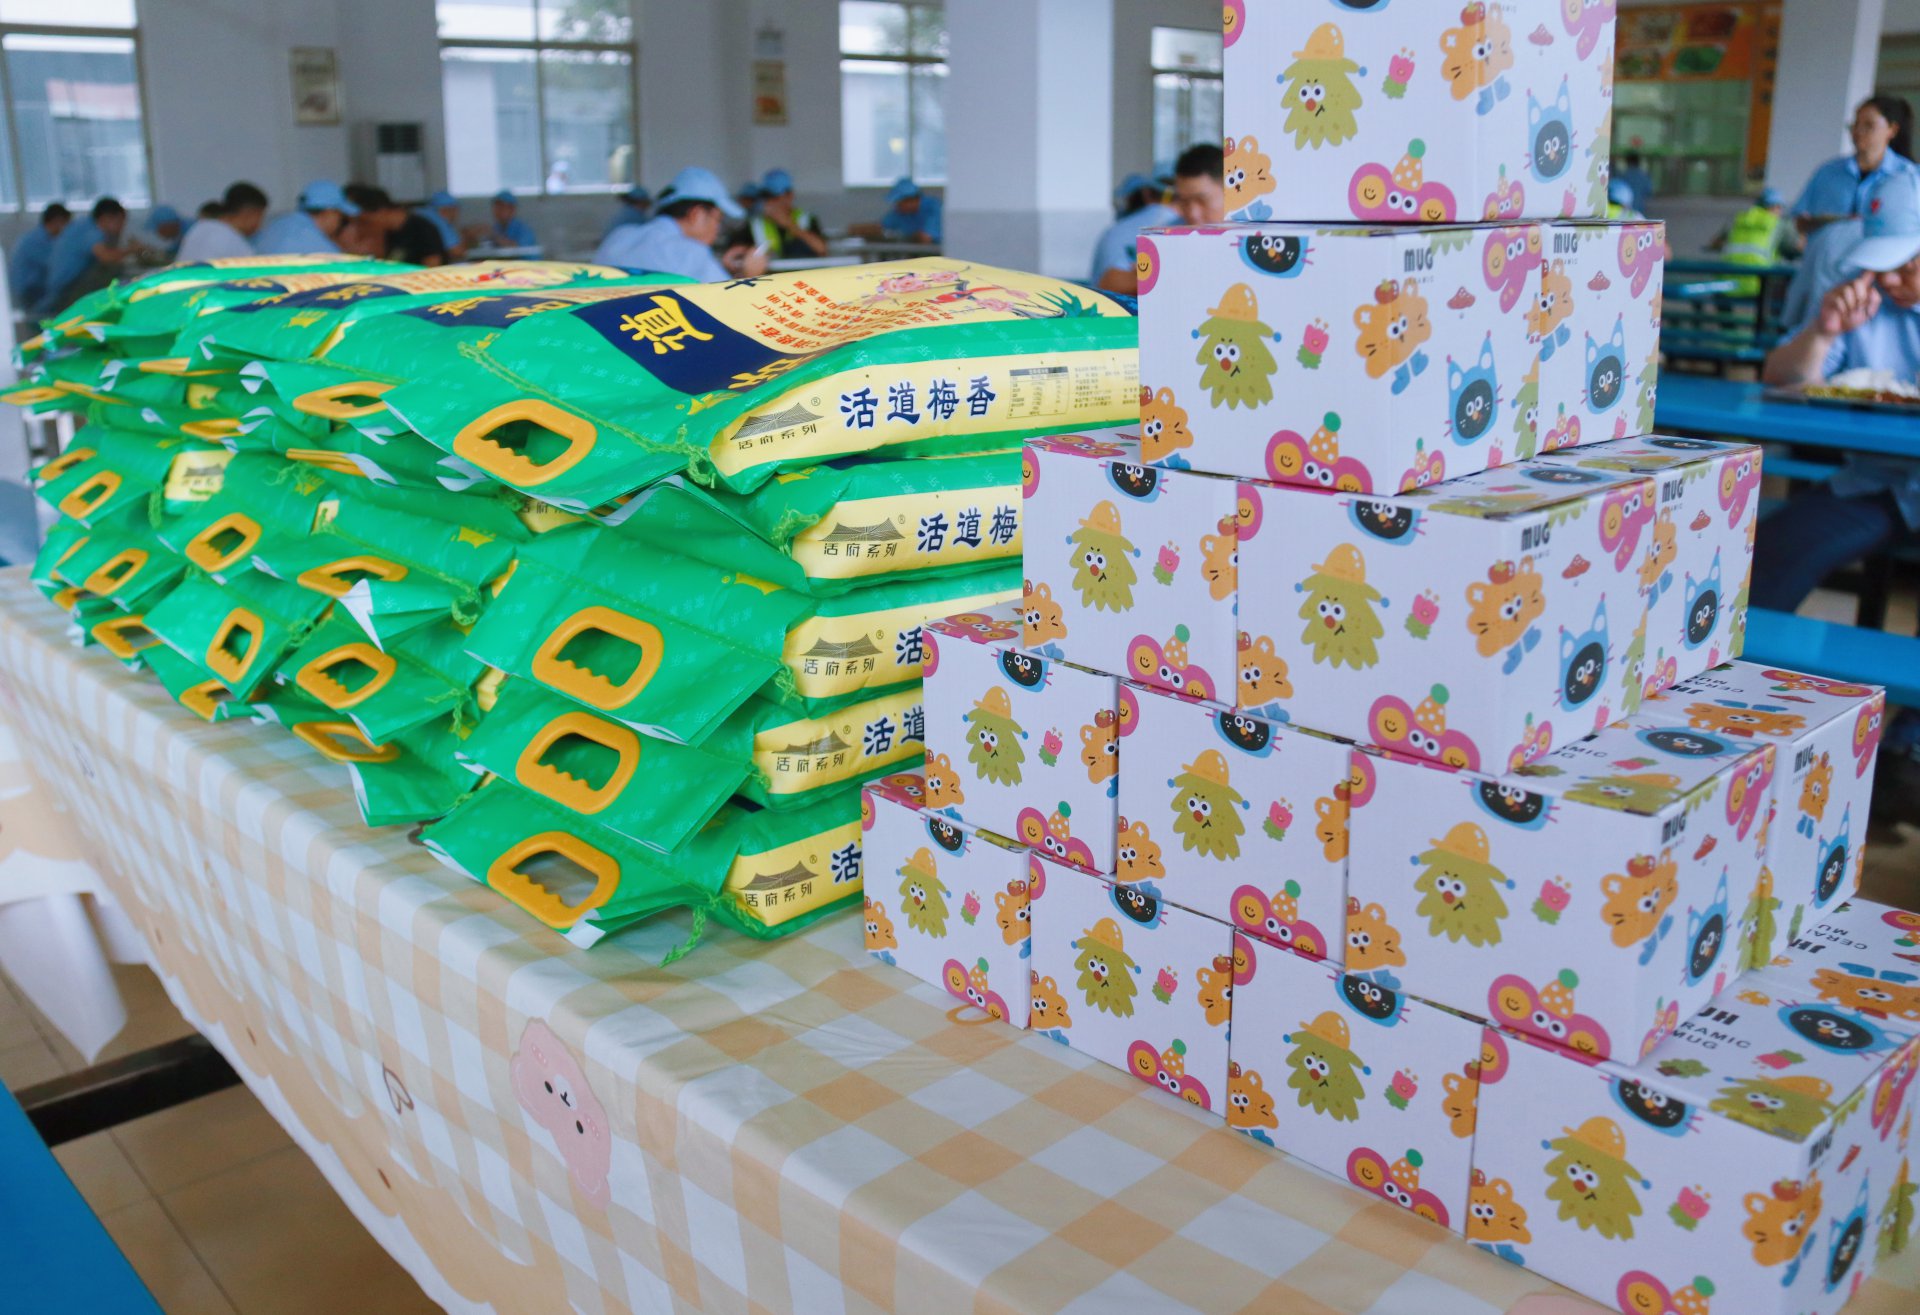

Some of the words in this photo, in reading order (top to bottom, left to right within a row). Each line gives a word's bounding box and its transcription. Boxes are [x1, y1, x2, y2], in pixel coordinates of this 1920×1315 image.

[1553, 233, 1578, 254] MUG
[1404, 247, 1433, 272] MUG
[838, 374, 998, 431] 活道梅香
[737, 423, 818, 452] 活府系列
[1662, 478, 1683, 504] MUG
[917, 504, 1019, 553] 活道梅
[1521, 521, 1550, 553] MUG
[823, 542, 897, 558] 活府系列
[895, 626, 923, 666] 活
[803, 657, 875, 675] 活府系列
[776, 752, 845, 774] 活府系列
[1793, 741, 1814, 774] MUG
[1661, 810, 1687, 846] MUG
[831, 842, 863, 884] 活
[744, 882, 813, 908] 活府系列
[1807, 929, 1868, 950] CERA
[1817, 924, 1849, 936] MU
[1697, 1007, 1740, 1027] JH
[1672, 1029, 1719, 1051] MUG
[1679, 1020, 1752, 1049] RAMIC
[1808, 1128, 1836, 1169] MUG
